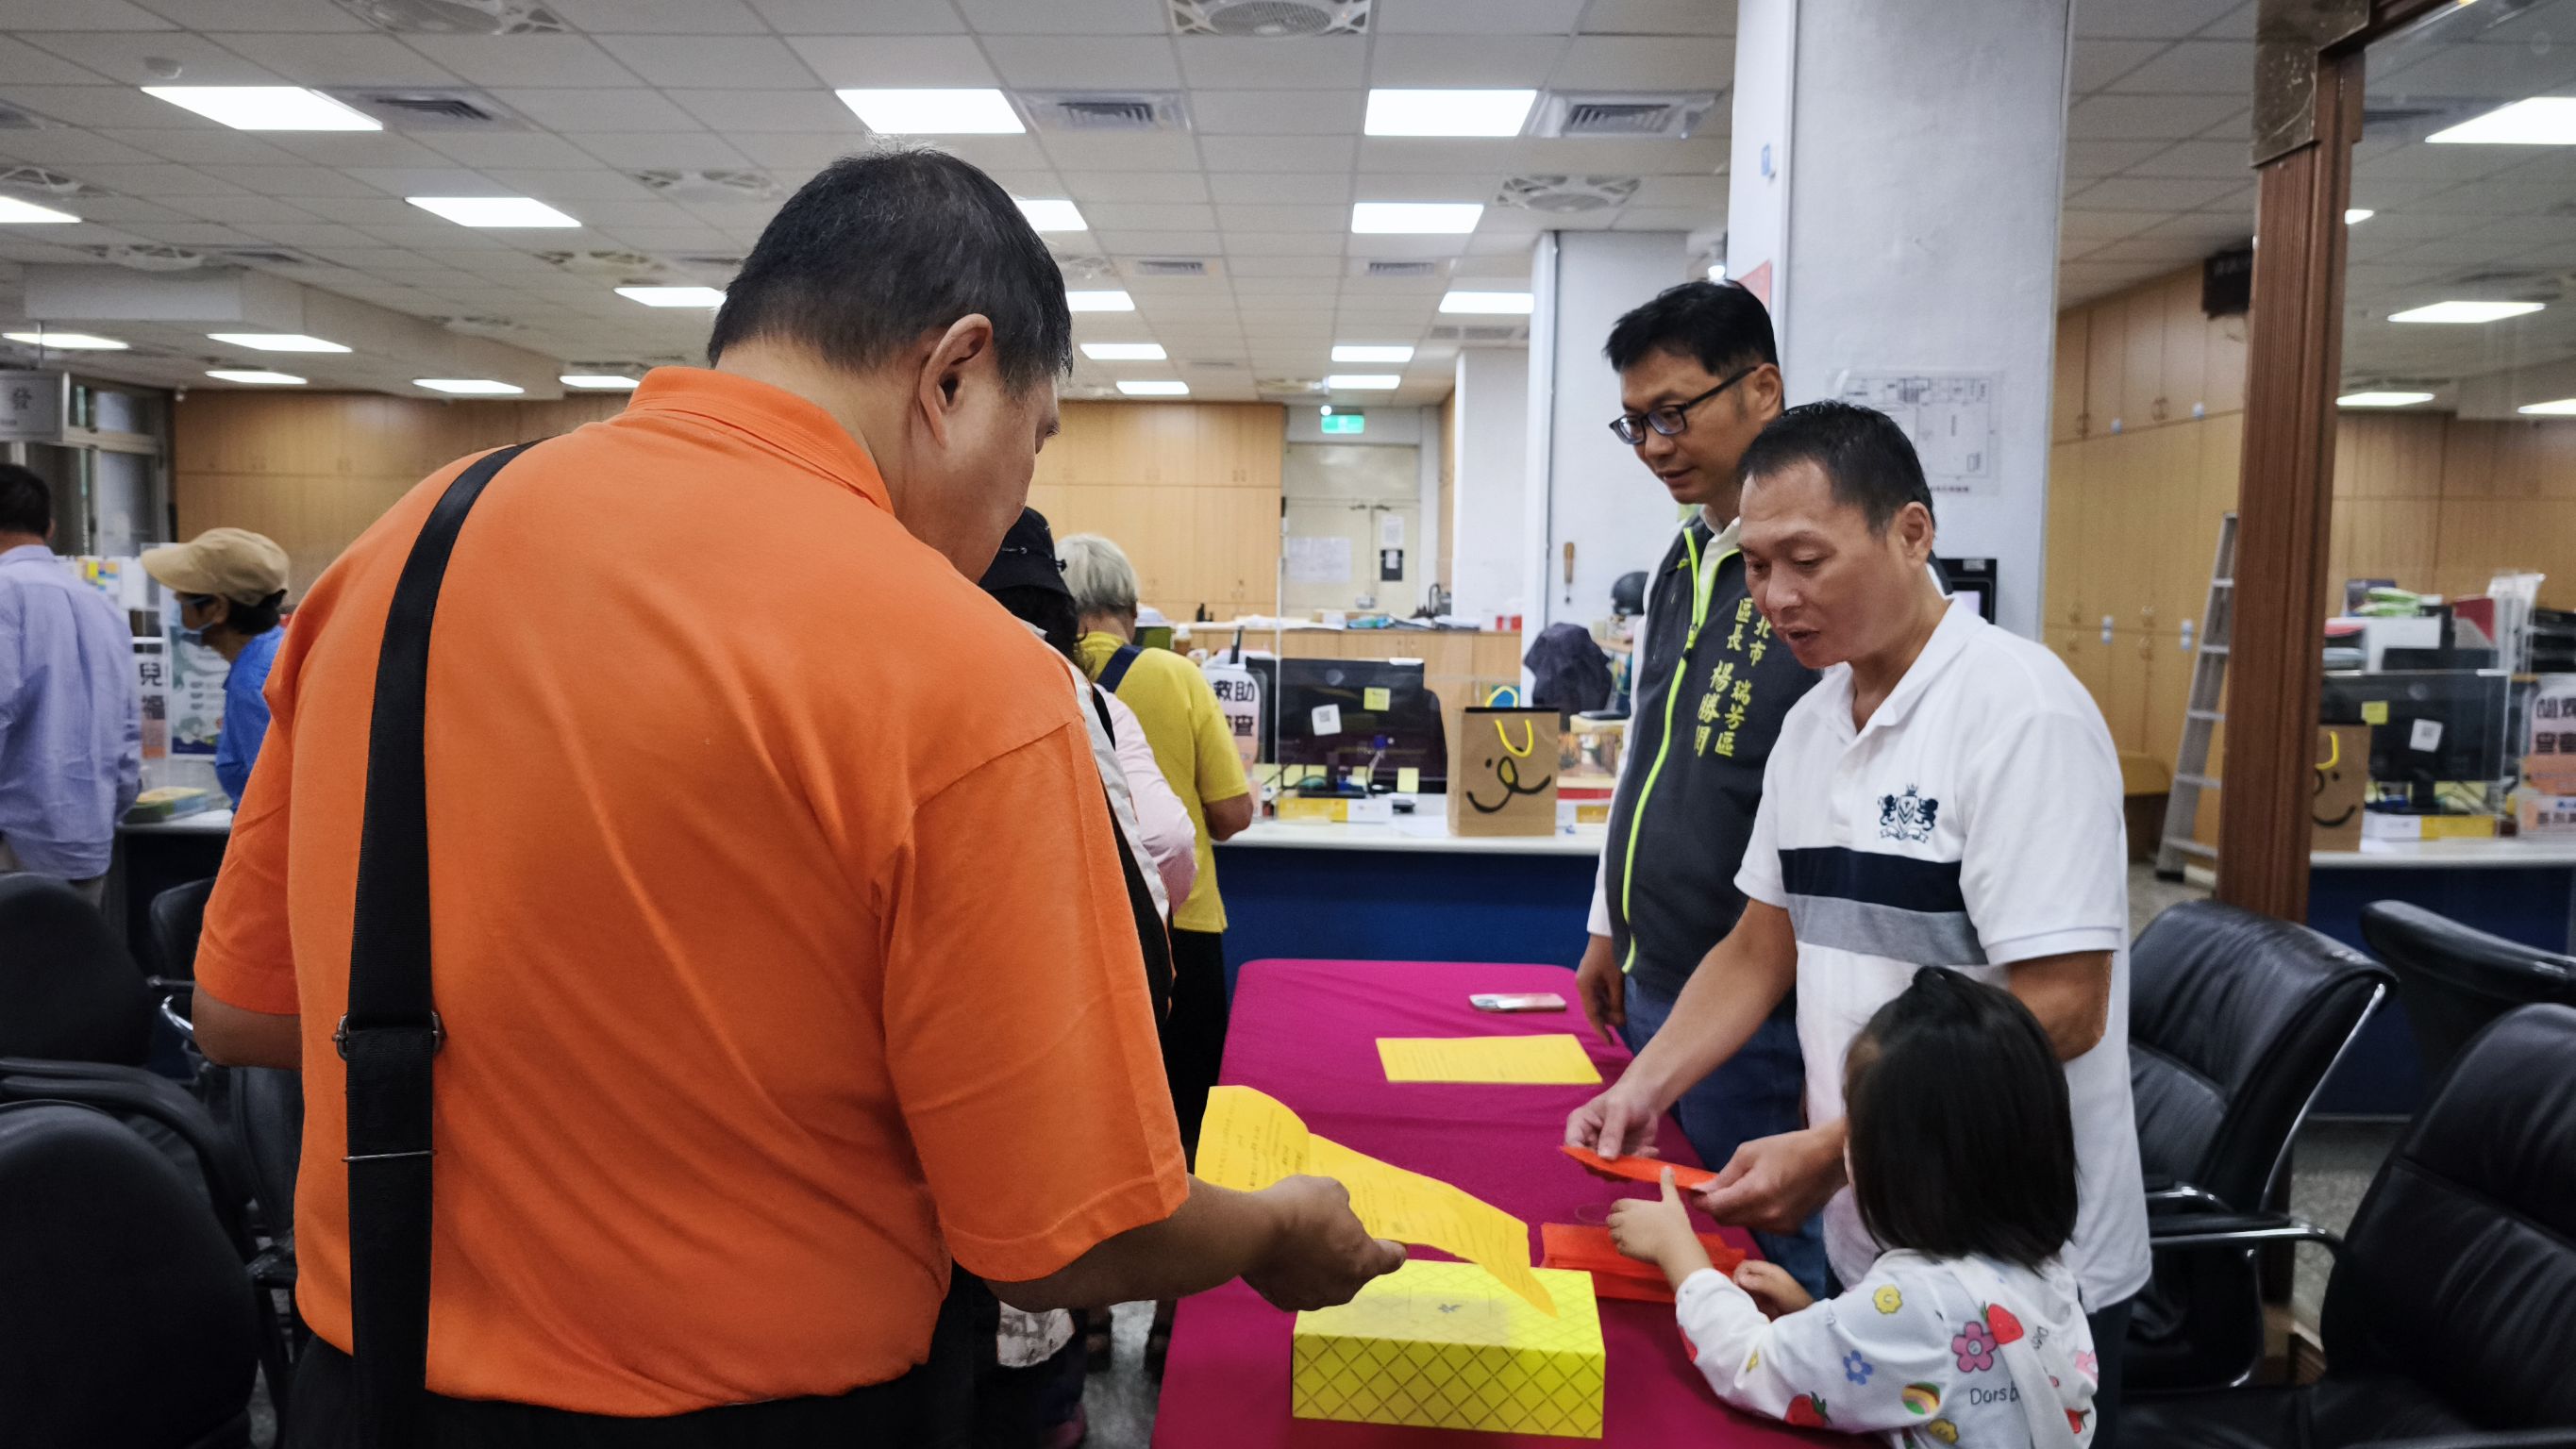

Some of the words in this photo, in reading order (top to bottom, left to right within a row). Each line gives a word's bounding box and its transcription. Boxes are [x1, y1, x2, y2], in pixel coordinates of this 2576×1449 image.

[1726, 597, 1754, 651] 區長
[1715, 679, 1753, 757] 瑞芳區
